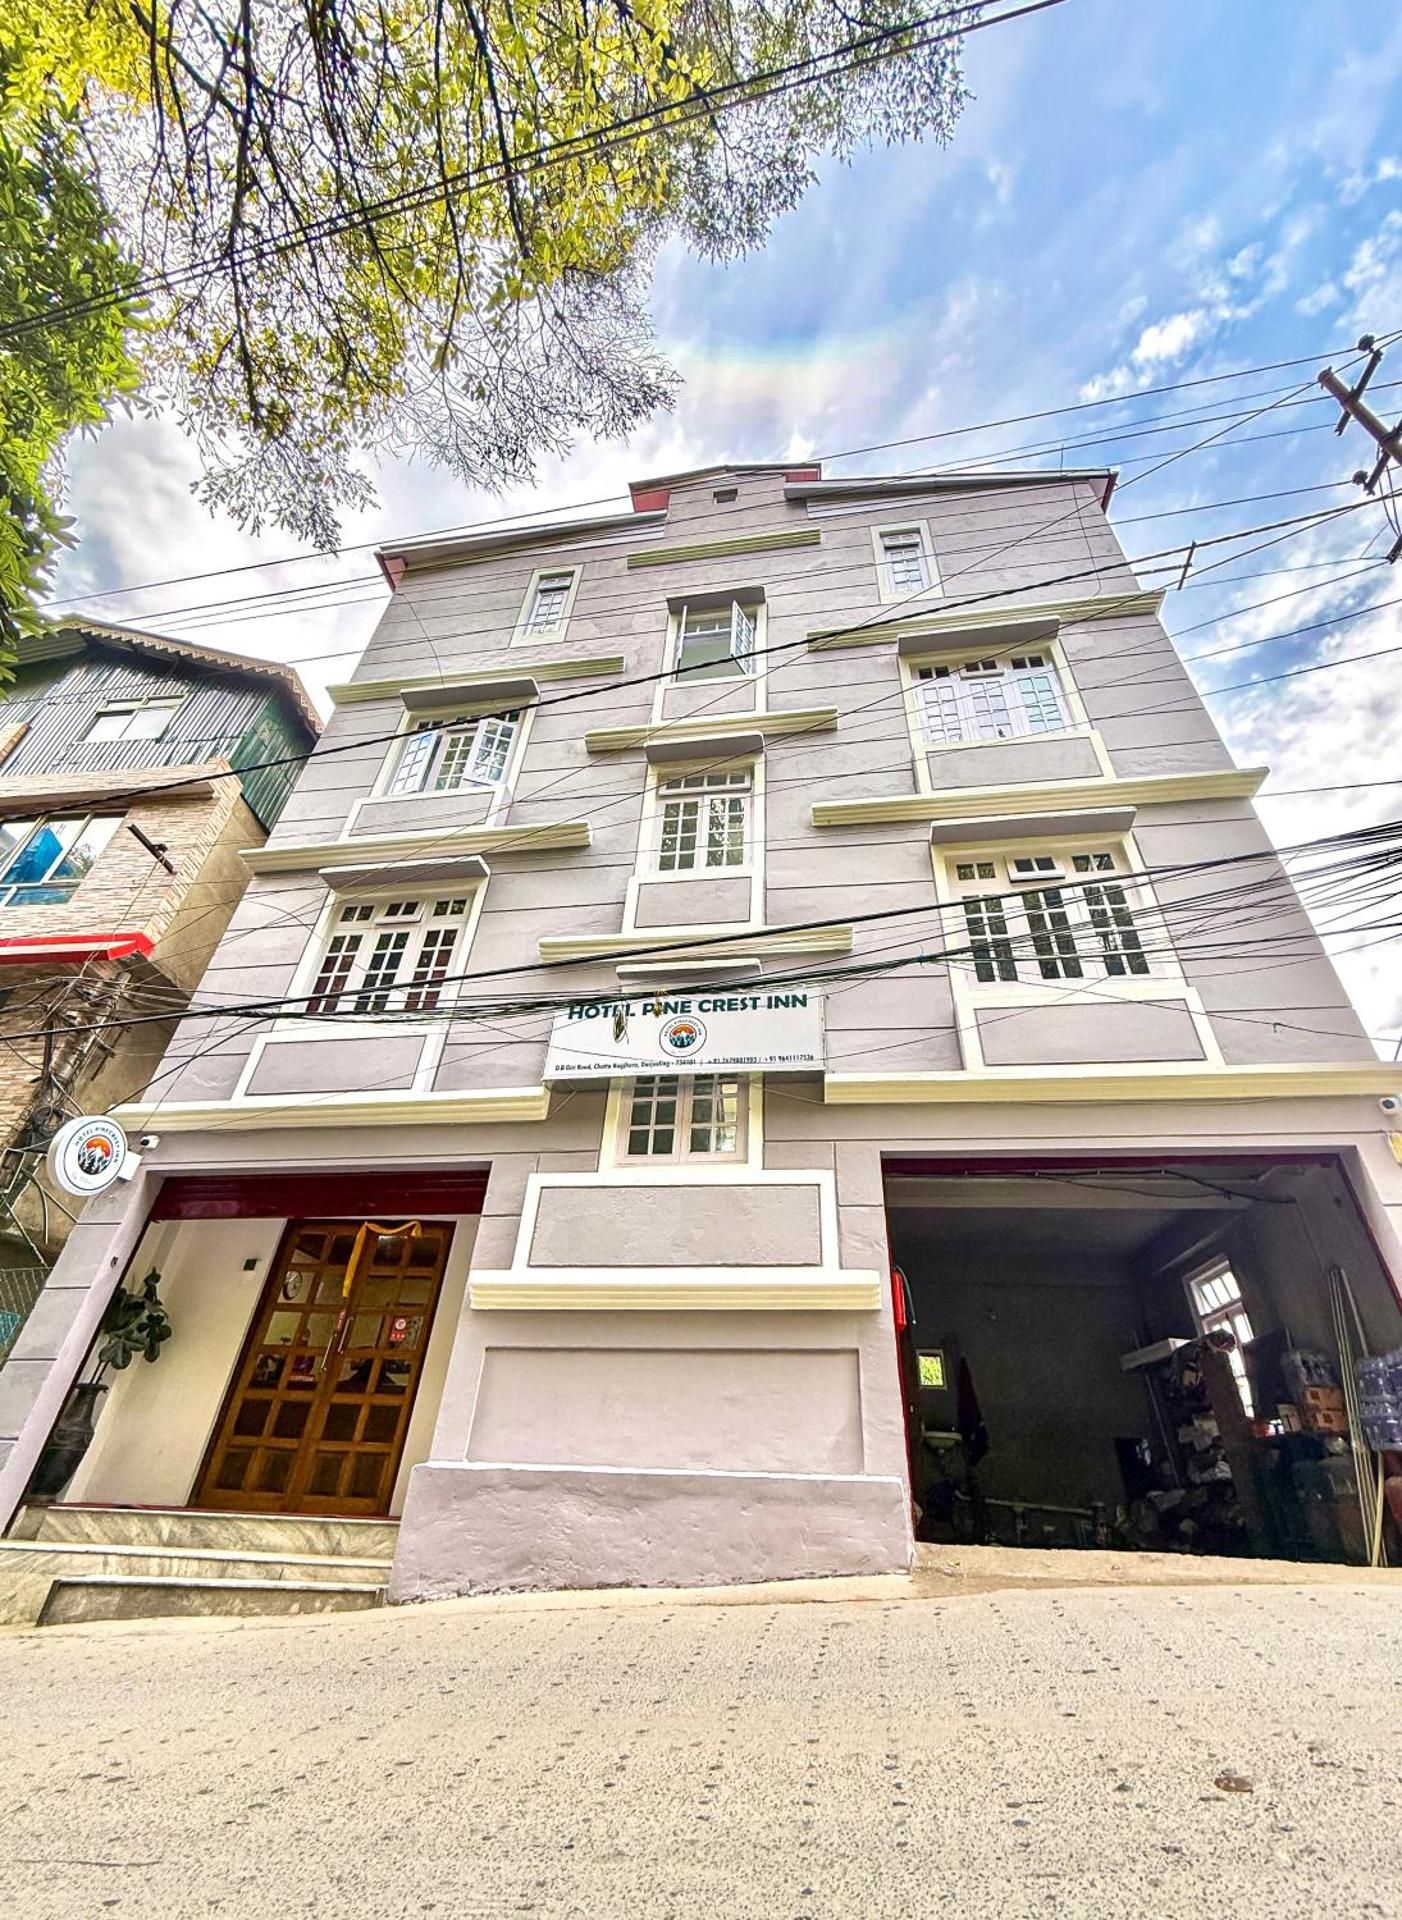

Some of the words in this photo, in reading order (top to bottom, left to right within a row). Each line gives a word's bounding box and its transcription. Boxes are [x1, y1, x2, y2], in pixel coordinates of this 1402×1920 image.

[642, 1000, 691, 1016] PNE
[698, 996, 760, 1013] CREST
[767, 994, 807, 1009] INN
